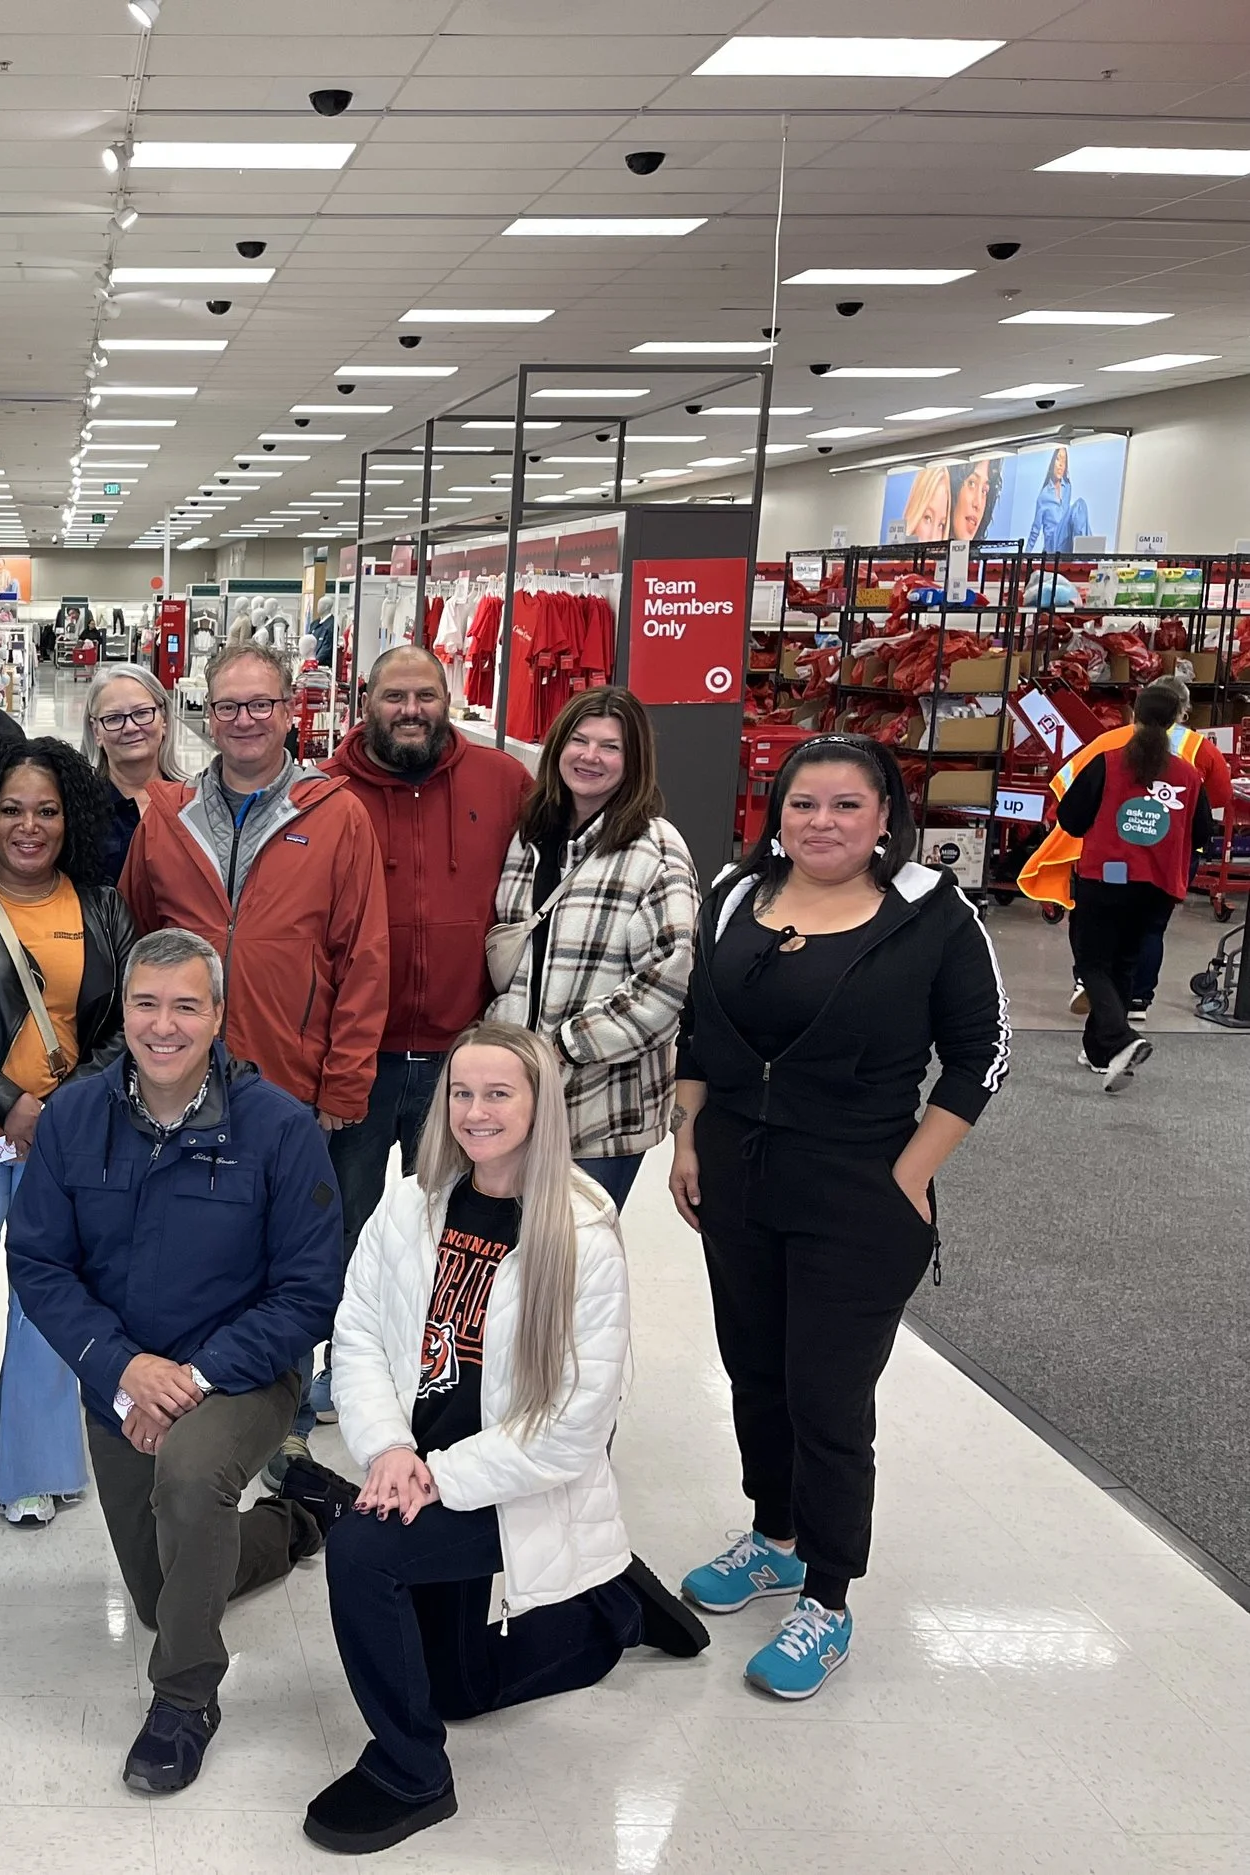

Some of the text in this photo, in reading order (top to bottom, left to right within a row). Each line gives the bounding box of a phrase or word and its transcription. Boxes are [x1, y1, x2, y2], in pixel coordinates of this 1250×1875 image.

[1138, 536, 1163, 544] GM 101
[644, 577, 696, 595] Team
[644, 598, 734, 616] Members
[643, 619, 687, 640] Only
[1003, 799, 1024, 814] up
[1126, 809, 1161, 820] ask me
[1128, 817, 1157, 827] about
[1131, 824, 1157, 836] circle
[749, 1565, 780, 1591] N
